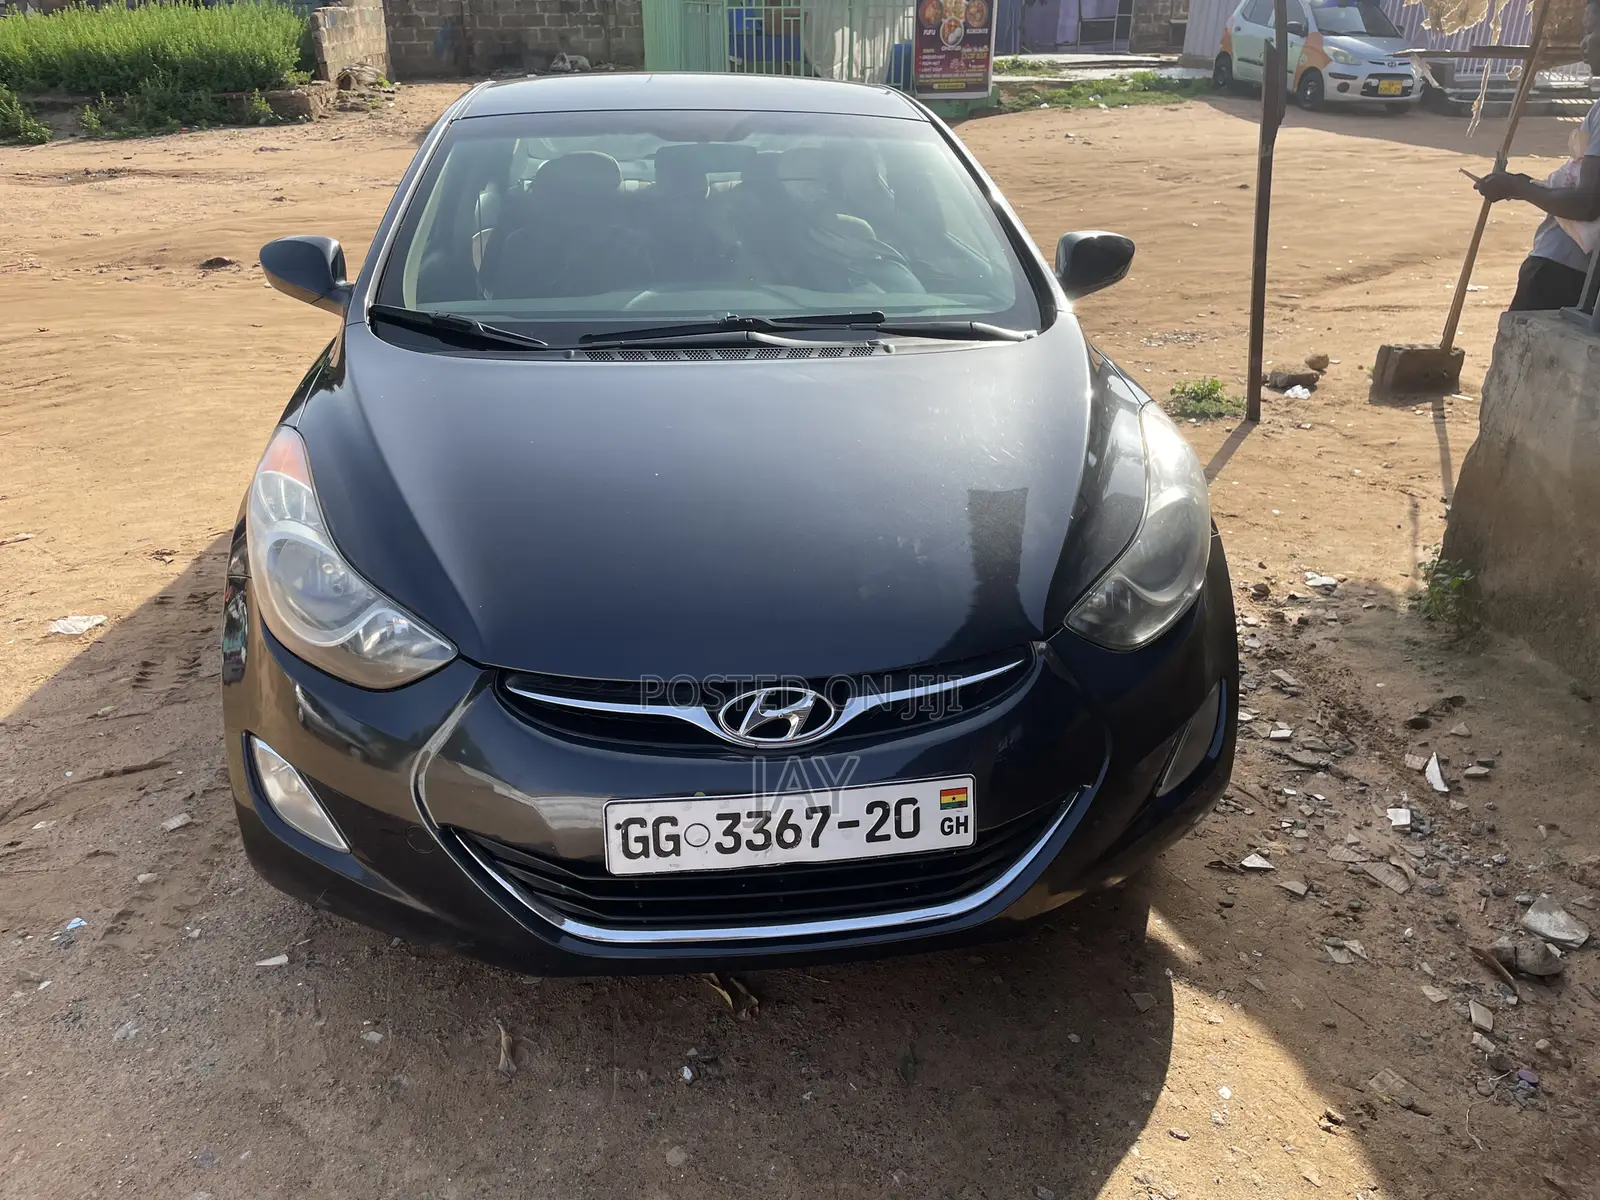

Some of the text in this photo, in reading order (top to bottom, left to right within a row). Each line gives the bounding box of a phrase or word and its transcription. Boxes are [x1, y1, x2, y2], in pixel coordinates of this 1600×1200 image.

[621, 797, 921, 860] GG 3367-20
[940, 815, 969, 837] GH
